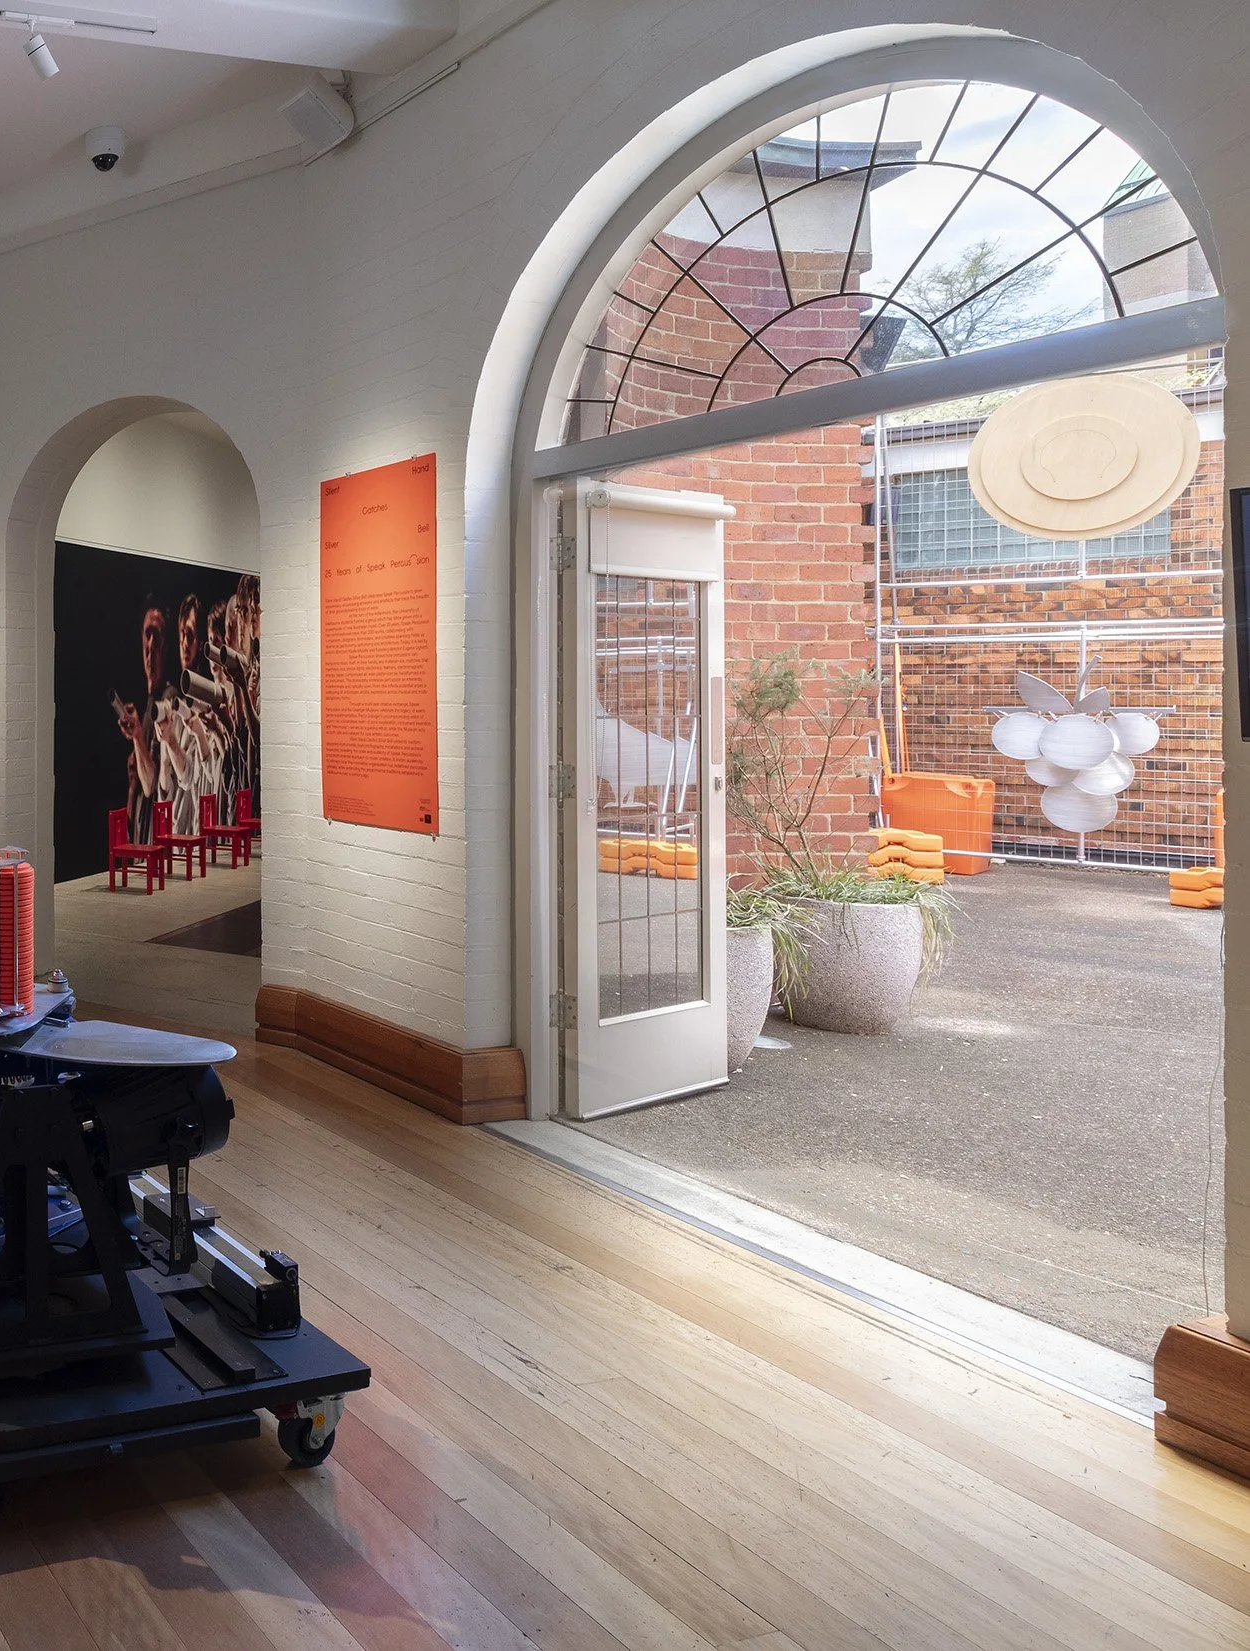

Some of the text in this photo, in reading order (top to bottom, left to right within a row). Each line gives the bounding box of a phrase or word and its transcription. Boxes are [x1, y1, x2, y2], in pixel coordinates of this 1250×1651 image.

[412, 464, 429, 475] Hand
[362, 504, 388, 515] Catches
[417, 523, 429, 533] Bell
[336, 567, 351, 577] Years
[356, 565, 362, 573] of
[367, 562, 386, 574] Speak
